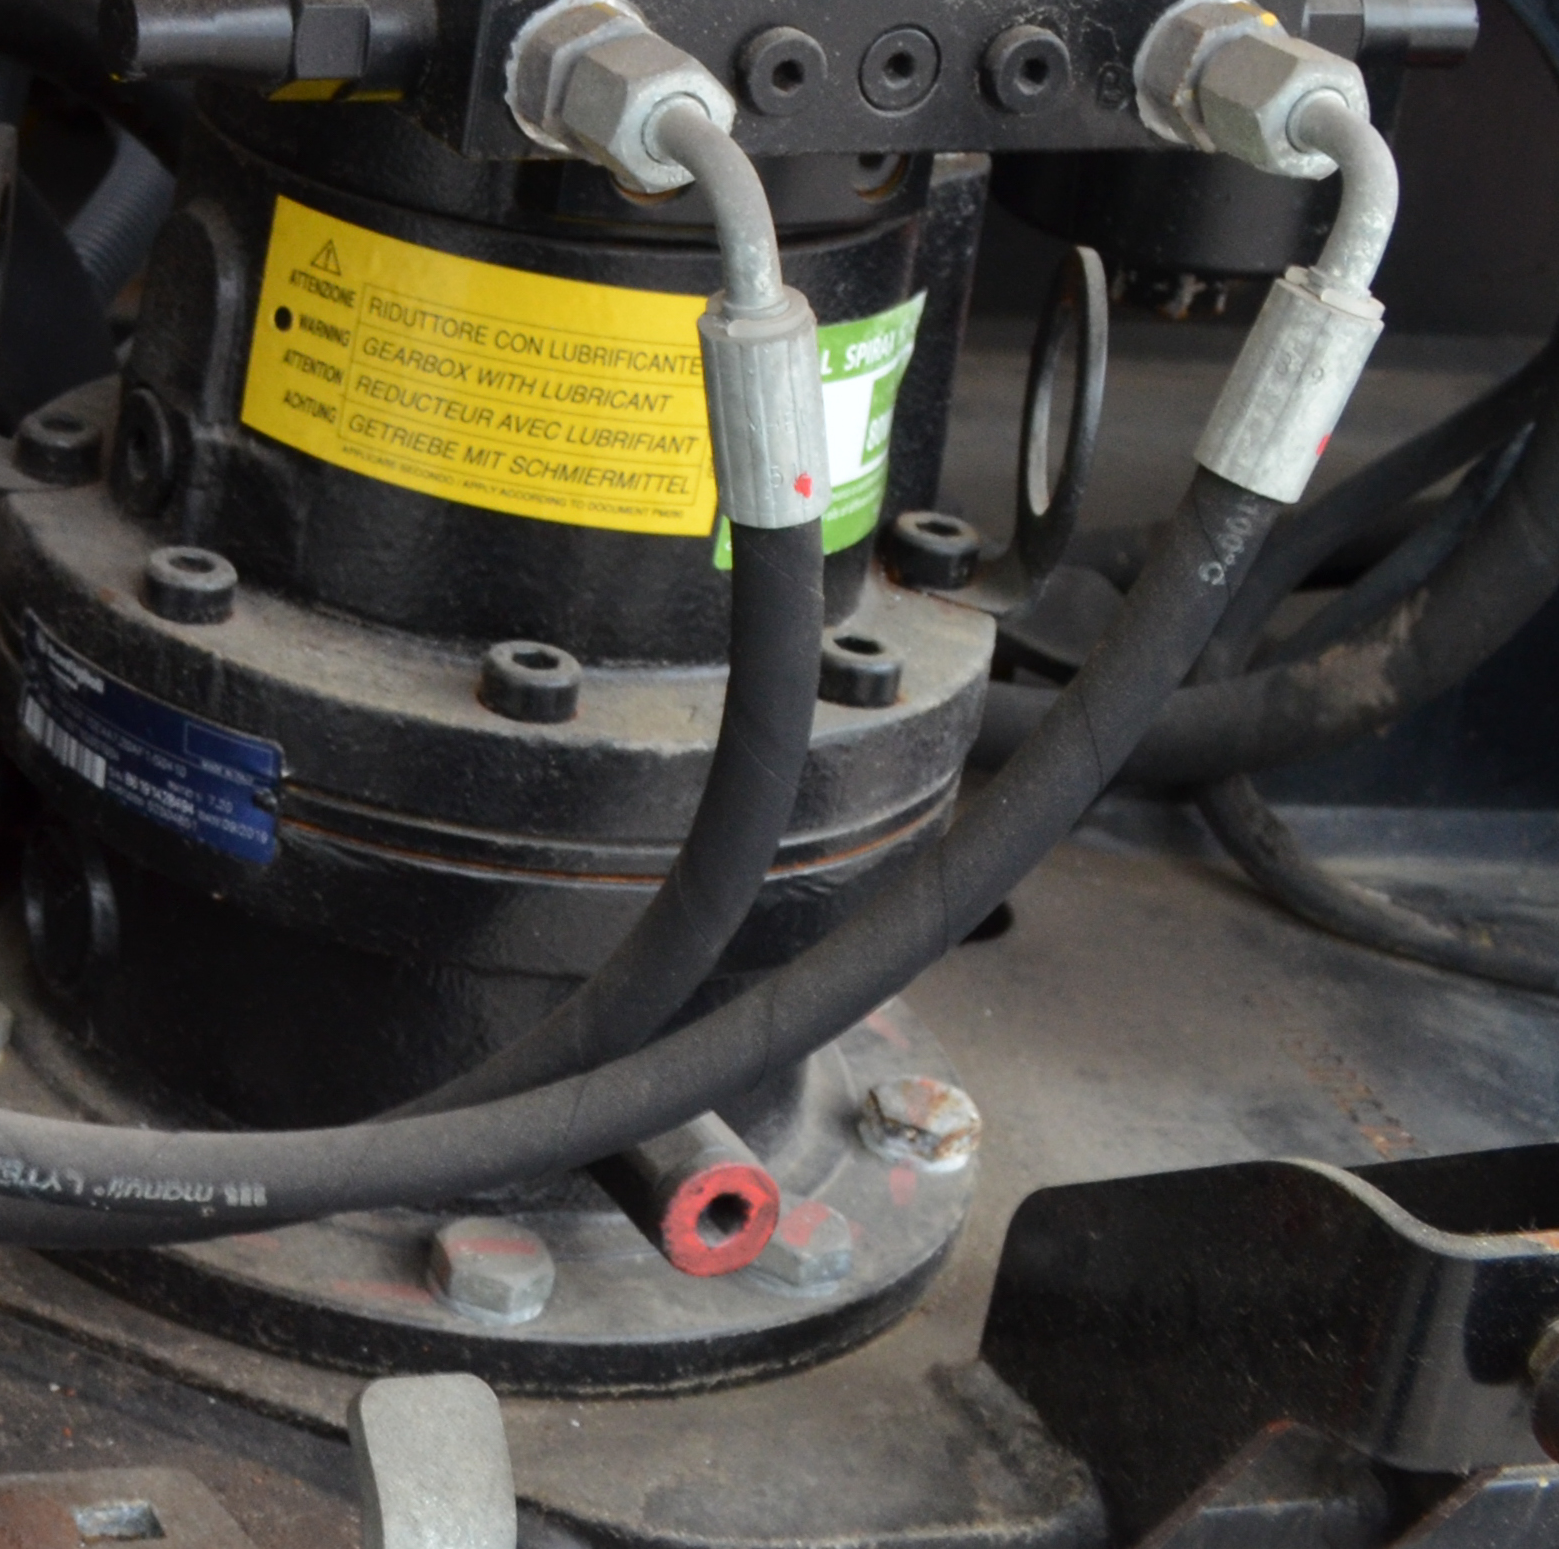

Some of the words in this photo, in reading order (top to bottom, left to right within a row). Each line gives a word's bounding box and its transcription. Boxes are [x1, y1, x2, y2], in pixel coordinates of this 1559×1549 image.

[289, 268, 357, 309] ATTENZIONE
[298, 313, 352, 348] WARNING
[368, 296, 489, 347] RIDUTTORE
[494, 329, 544, 357] CON
[548, 339, 702, 376] LUBRIFICANTE
[283, 348, 347, 387] ATTENTION
[362, 336, 473, 383] GEARBOX
[476, 366, 538, 396] WITH
[540, 379, 675, 414] LUBRICANT
[282, 389, 339, 425] ACHTUNG
[355, 374, 495, 428] REDUCTEUR
[496, 412, 563, 441] AVEC
[565, 424, 700, 456] LUBRIFIANT
[348, 413, 460, 462] GETRIEBE
[462, 444, 508, 471] MIT
[509, 454, 693, 496] SCHMIERMITTEL
